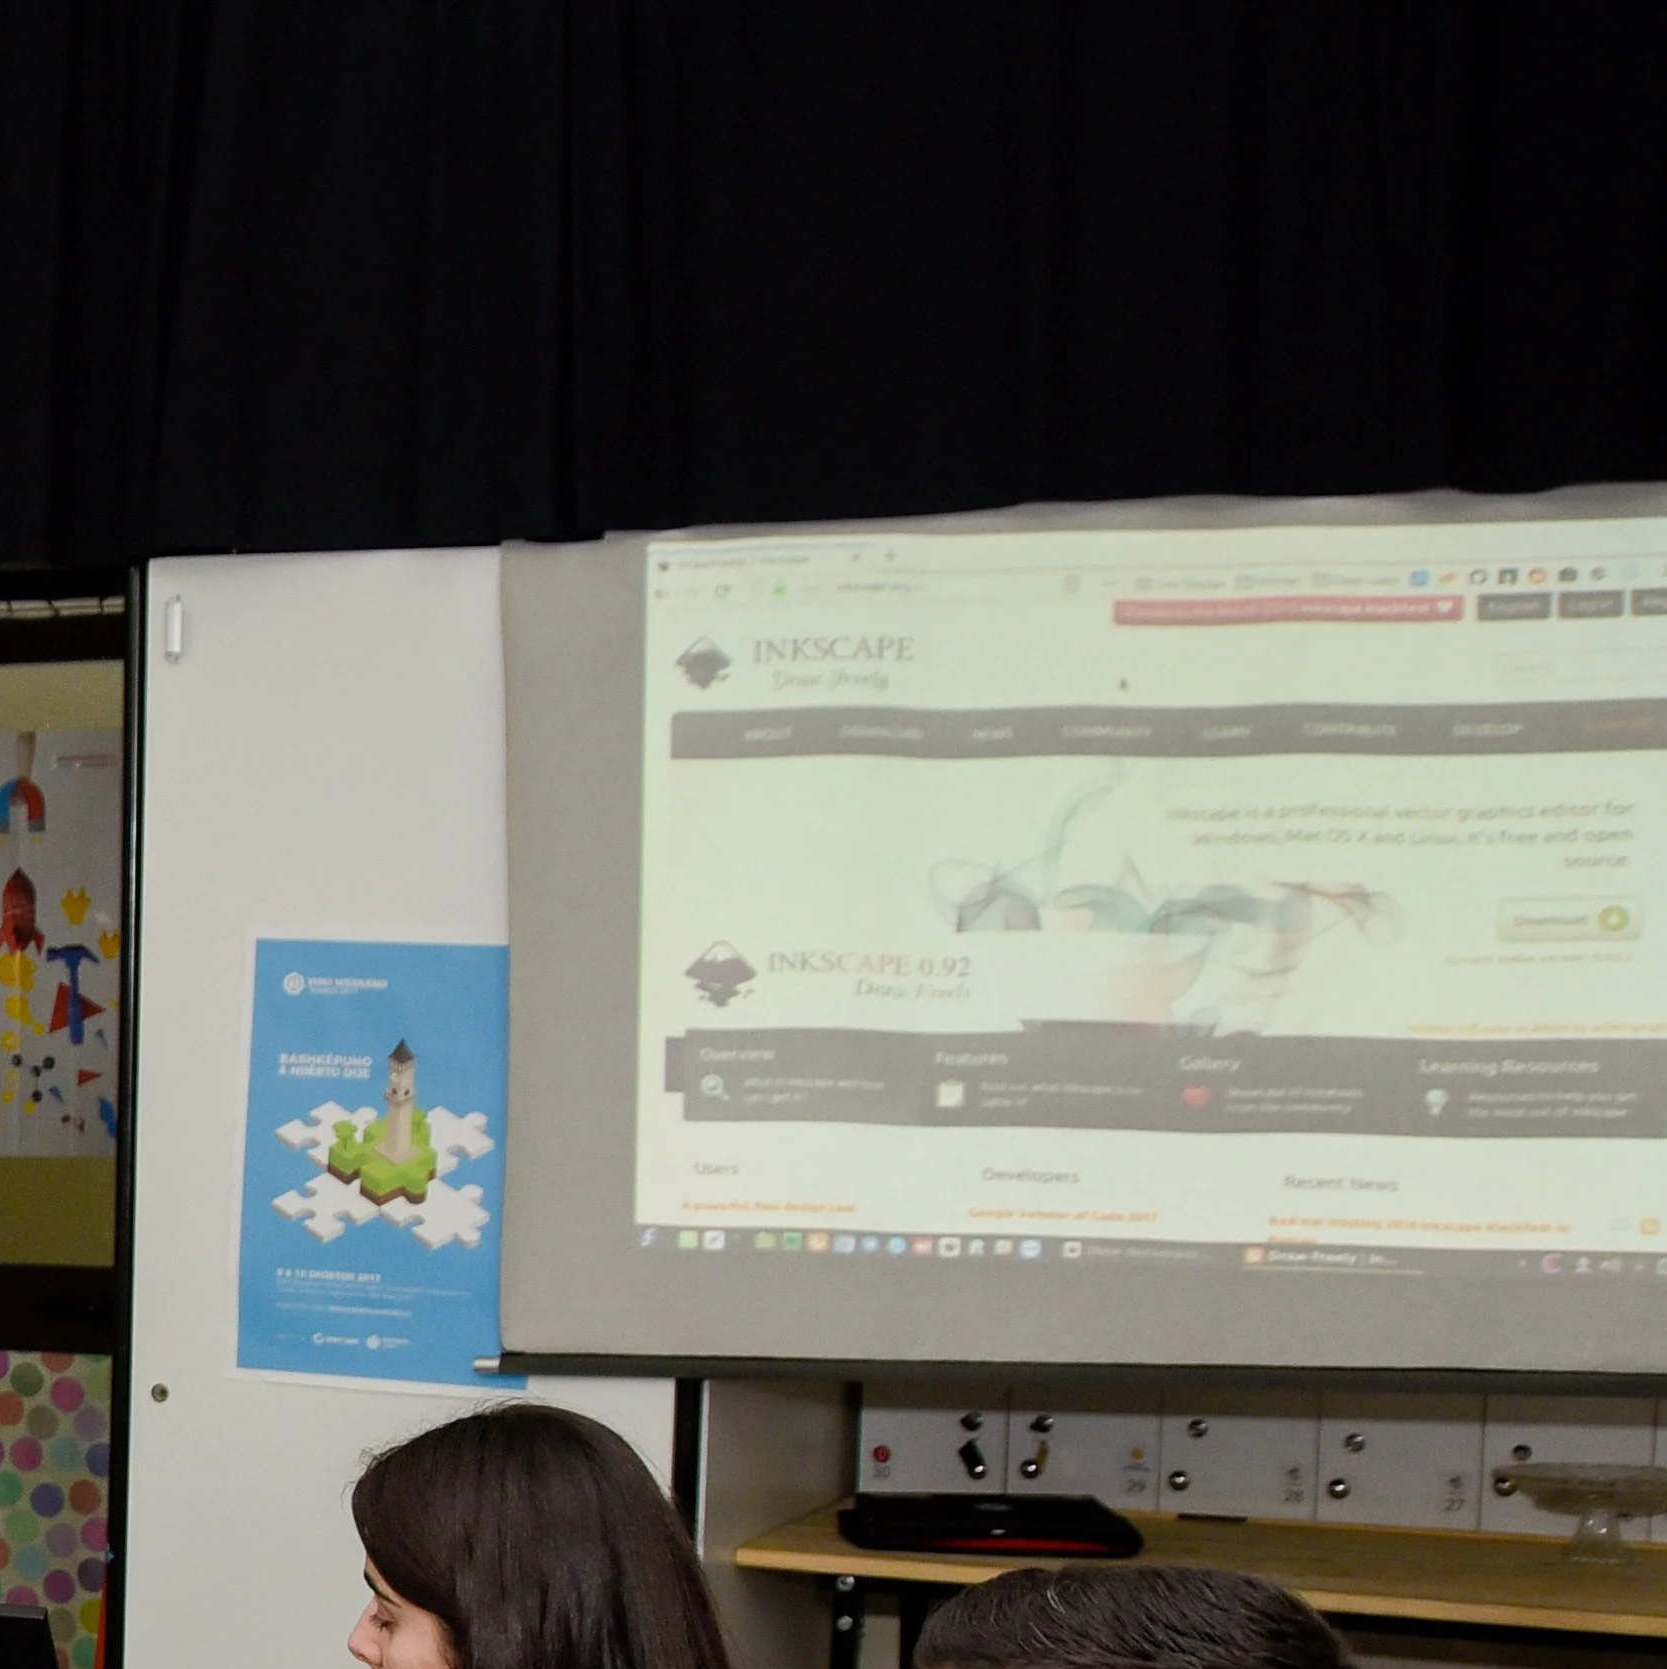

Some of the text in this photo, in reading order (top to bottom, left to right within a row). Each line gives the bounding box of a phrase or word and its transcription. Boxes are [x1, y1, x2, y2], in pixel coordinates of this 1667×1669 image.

[753, 636, 916, 664] INKSCAPE
[768, 951, 971, 977] INKSCAPE 0.92
[1179, 1054, 1242, 1072] Gallery
[1418, 1057, 1497, 1077] Learning
[693, 1160, 739, 1176] Users
[981, 1165, 1080, 1185] Developers
[1284, 1174, 1399, 1193] Recent News
